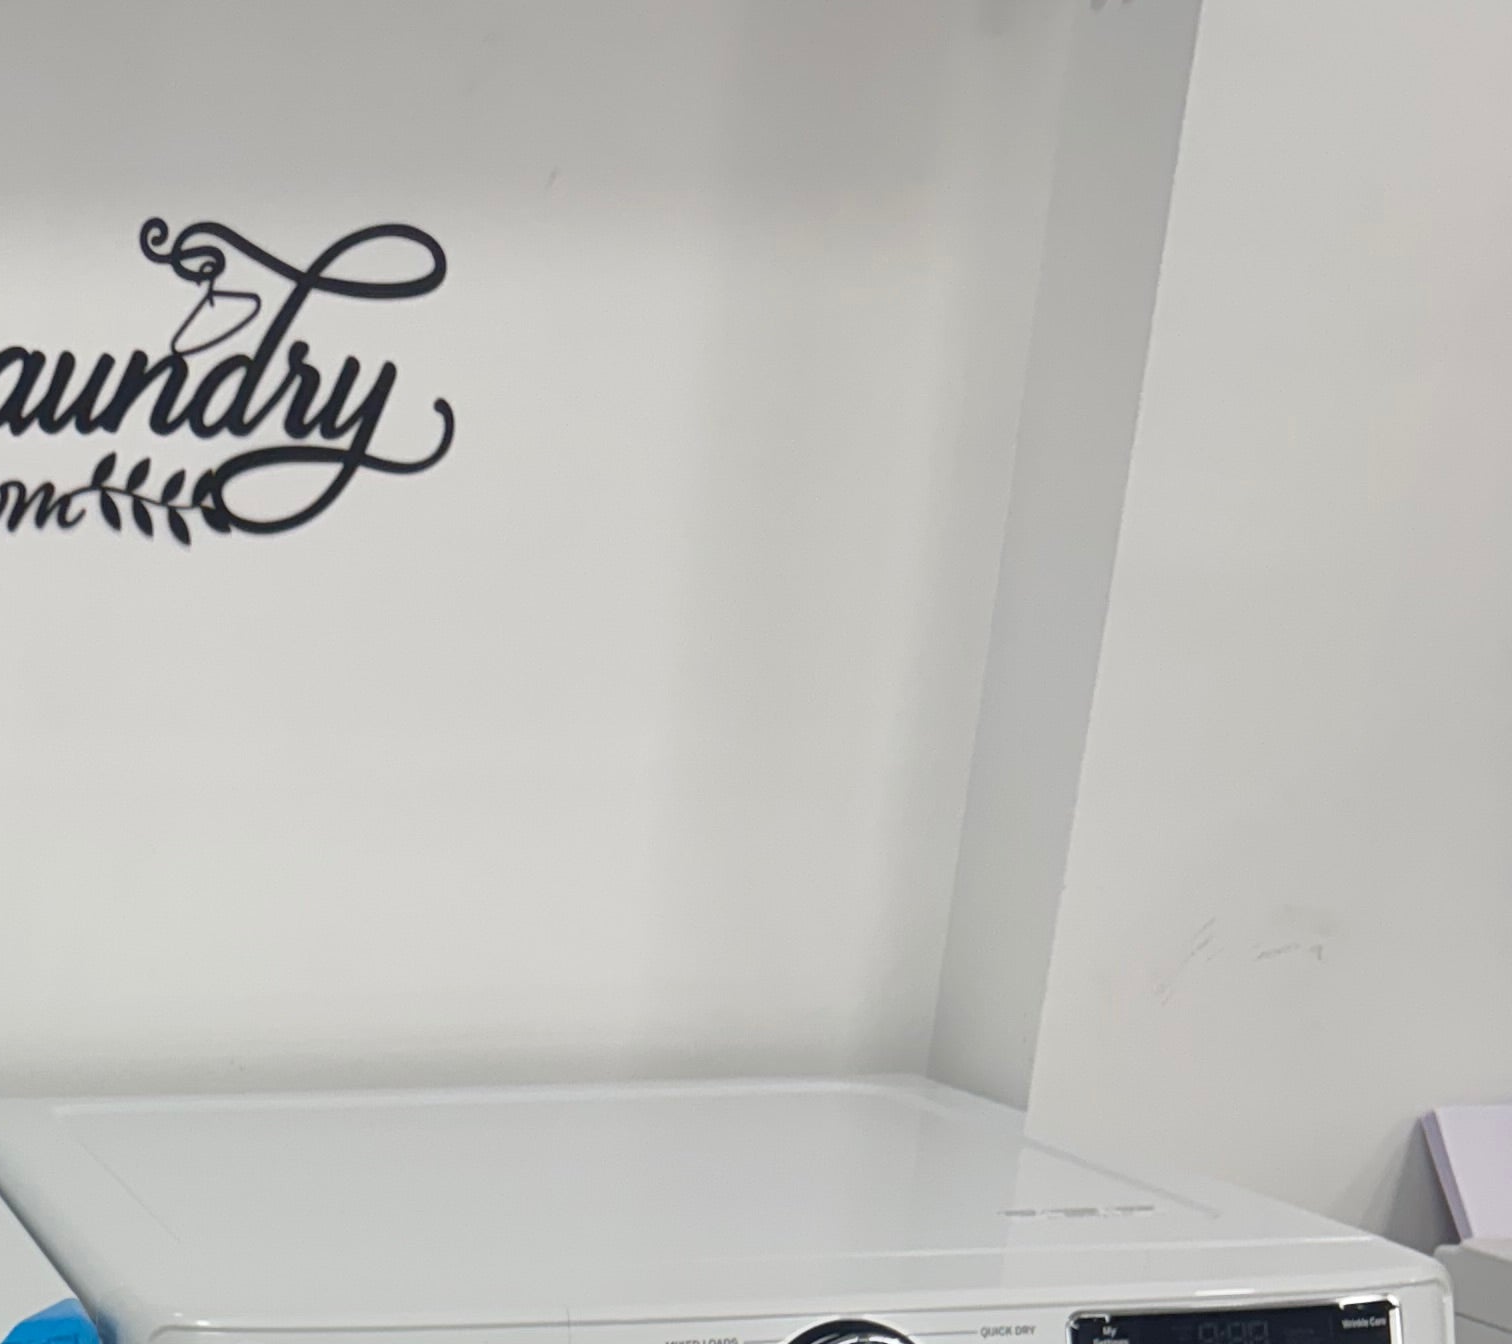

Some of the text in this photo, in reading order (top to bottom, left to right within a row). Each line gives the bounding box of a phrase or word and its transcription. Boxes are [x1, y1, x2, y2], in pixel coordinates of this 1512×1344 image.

[980, 1325, 1037, 1338] QUICK DRY
[1102, 1326, 1118, 1338] My
